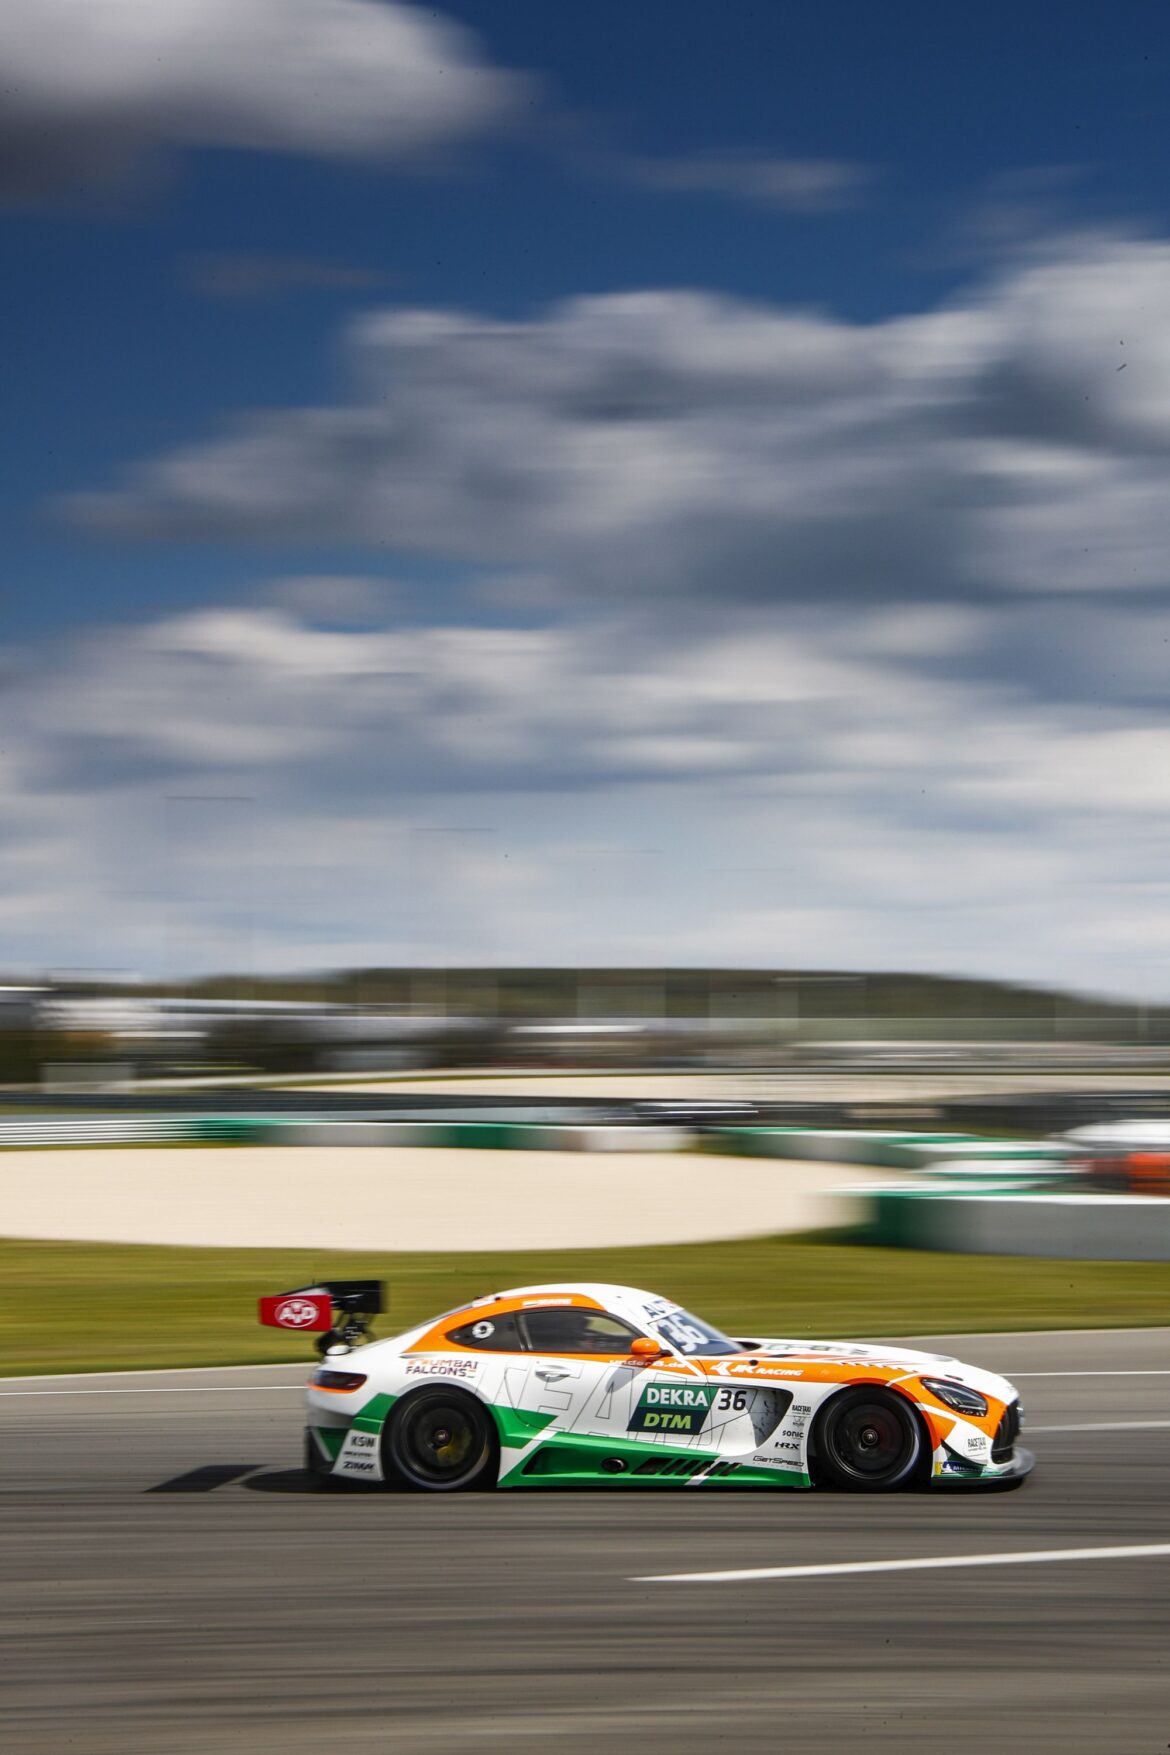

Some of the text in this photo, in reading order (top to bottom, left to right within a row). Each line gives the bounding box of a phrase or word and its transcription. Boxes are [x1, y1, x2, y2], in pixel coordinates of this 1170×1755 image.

[405, 1366, 466, 1377] FALCONS
[756, 1368, 804, 1376] RACING
[646, 1387, 709, 1407] DEKRA
[717, 1389, 748, 1411] 36
[643, 1412, 692, 1430] DTM
[774, 1441, 801, 1450] HRX
